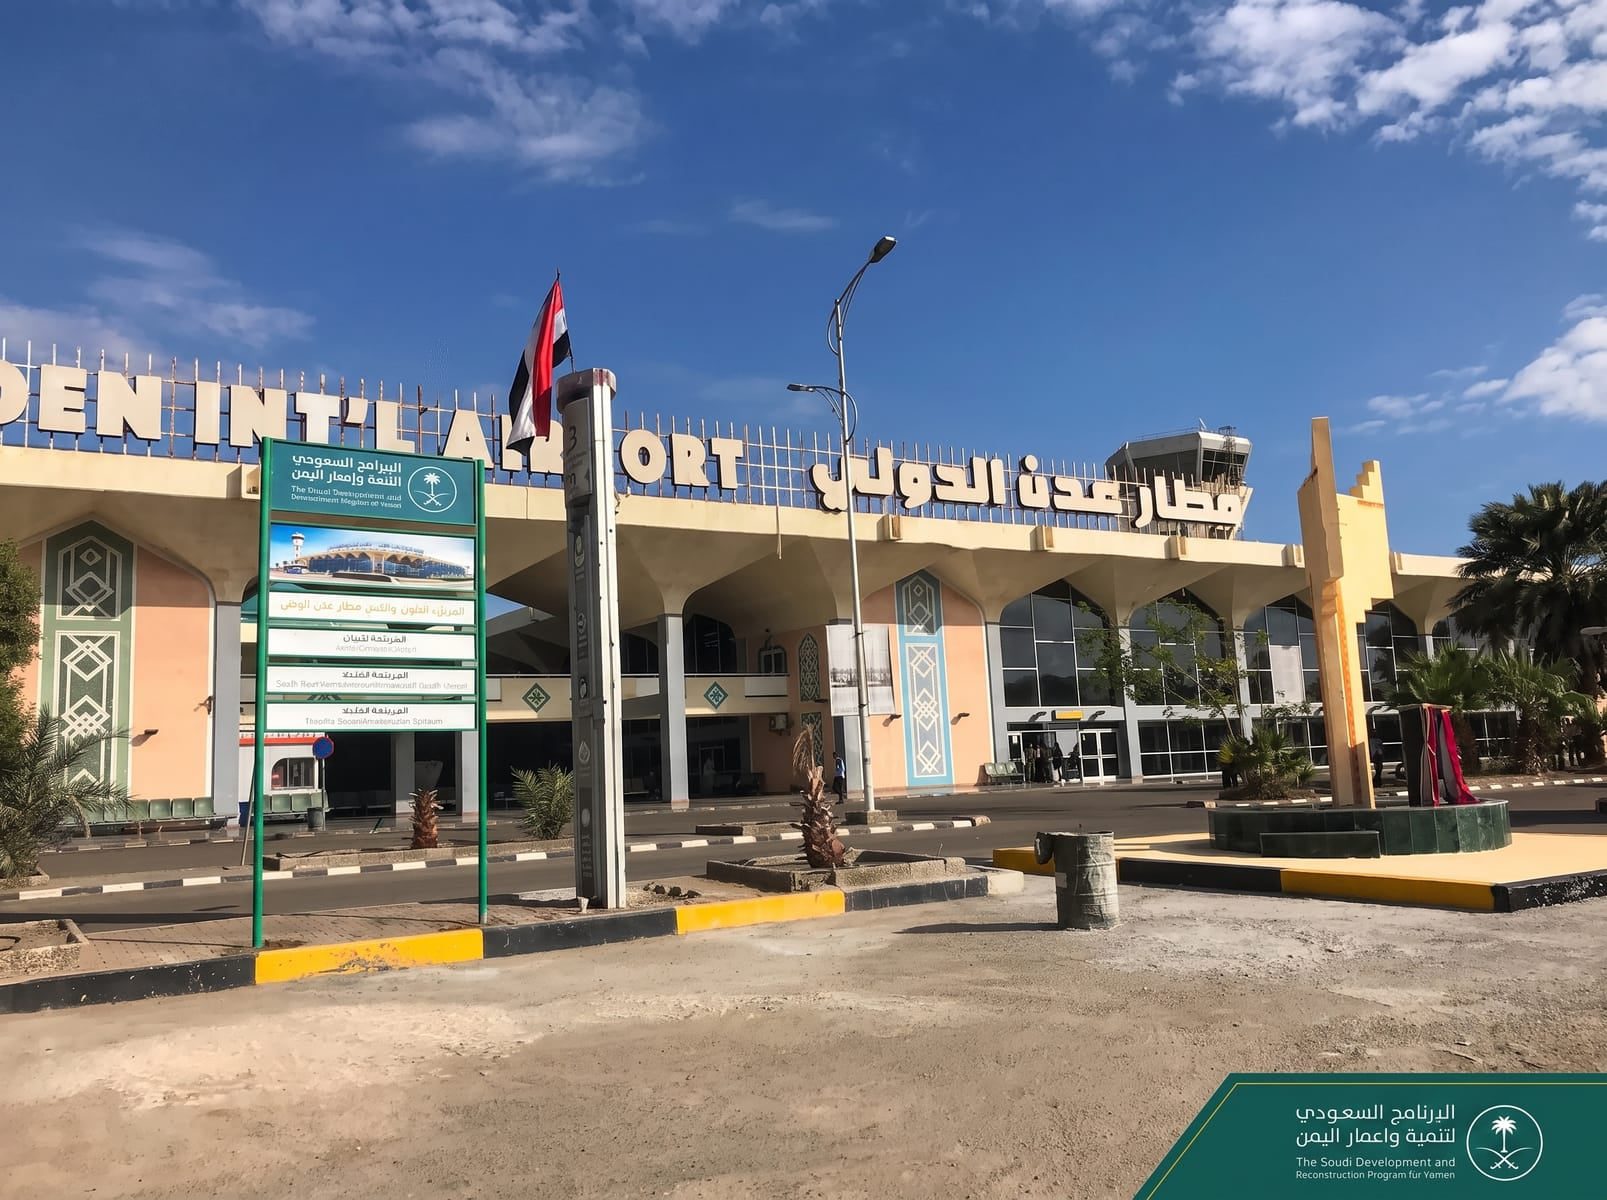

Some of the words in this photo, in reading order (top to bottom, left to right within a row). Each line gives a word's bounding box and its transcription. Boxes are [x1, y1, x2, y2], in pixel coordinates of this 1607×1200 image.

[194, 380, 416, 453] INT'L
[291, 469, 324, 482] اليمن
[1018, 454, 1123, 515] عدن
[1133, 475, 1242, 529] مطار
